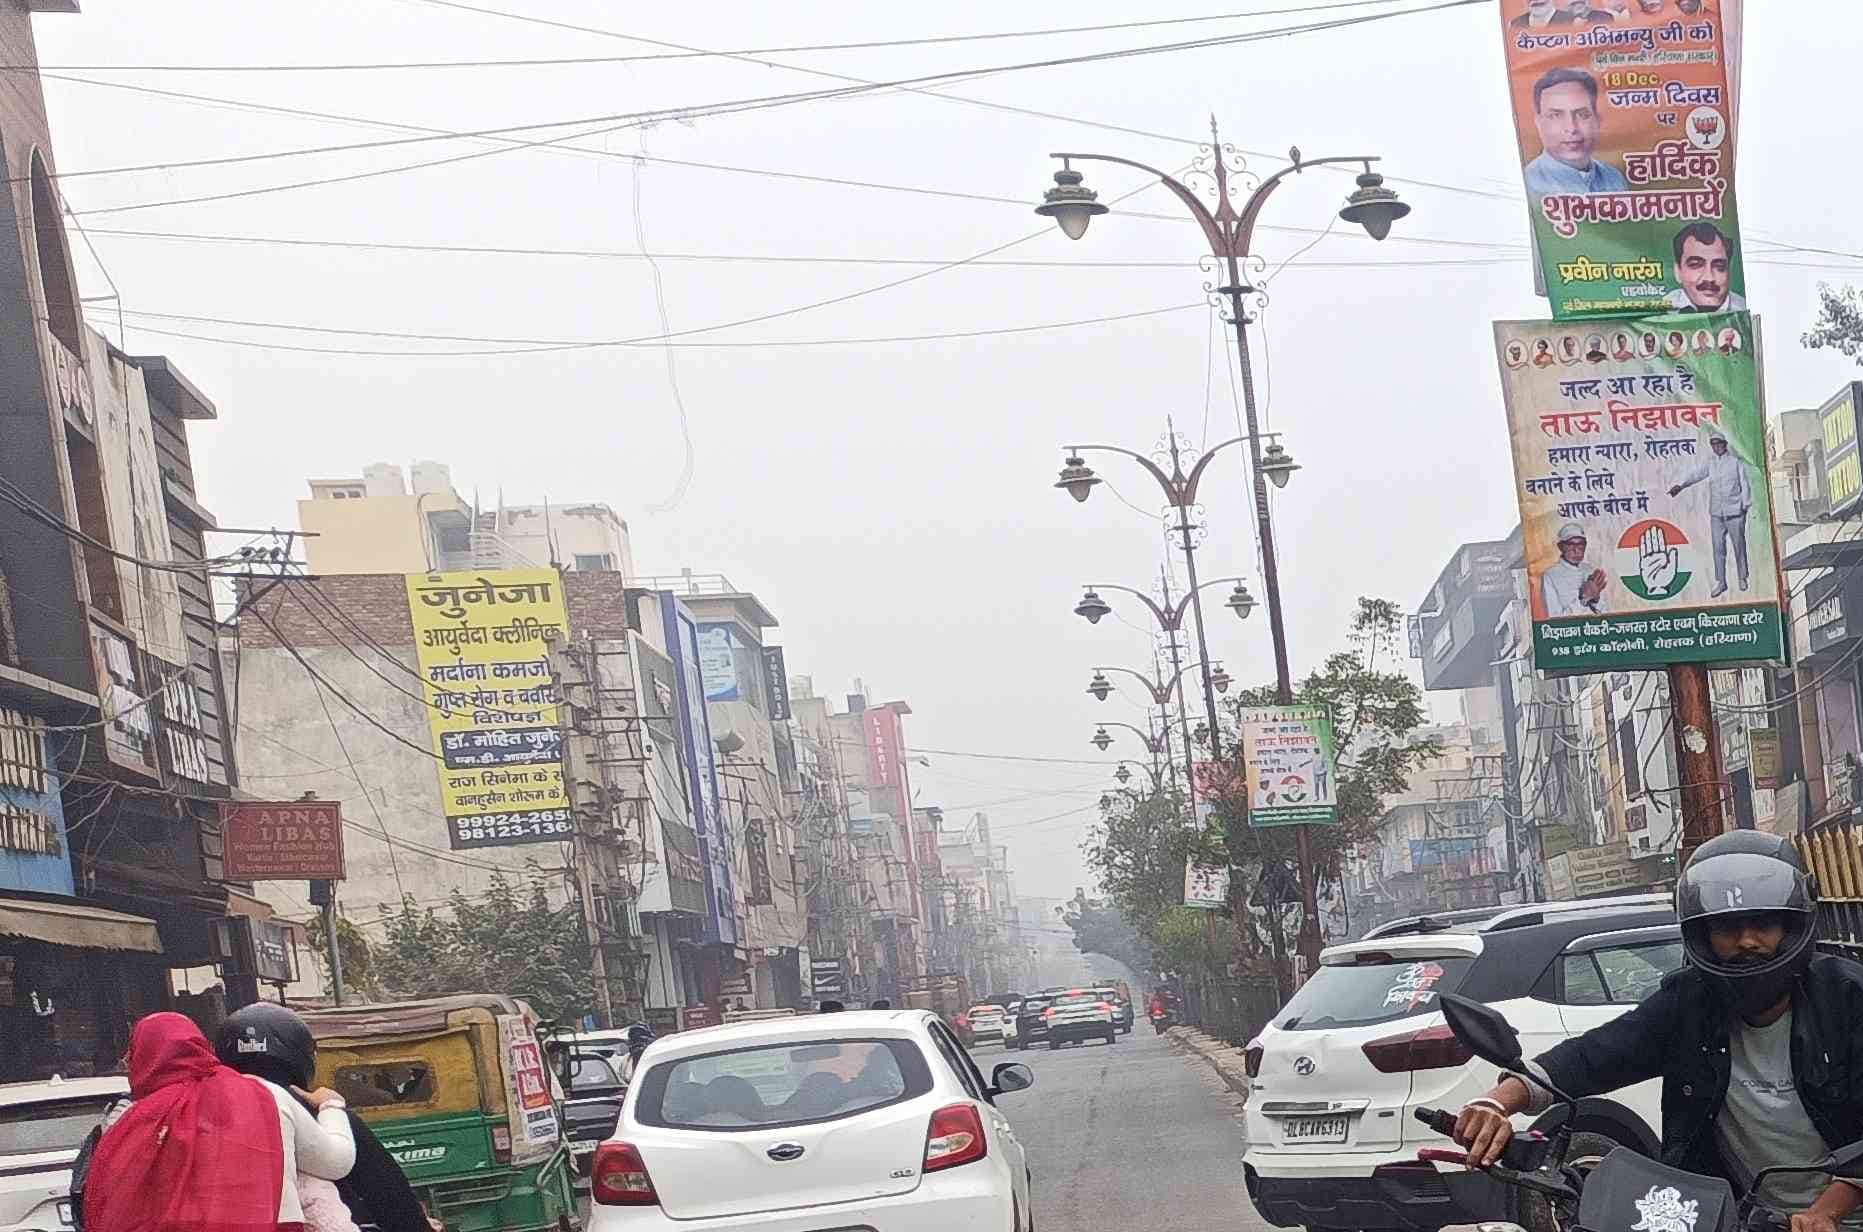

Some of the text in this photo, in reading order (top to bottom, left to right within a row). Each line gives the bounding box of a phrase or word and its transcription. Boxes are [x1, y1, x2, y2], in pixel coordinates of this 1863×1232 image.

[1577, 26, 1654, 49] अभिमन्यु
[1660, 24, 1682, 42] जी
[1690, 22, 1713, 41] को
[1602, 72, 1663, 86] 18 Dec.
[1607, 81, 1720, 106] जन्म दिवस
[1657, 112, 1676, 125] पर
[1624, 141, 1719, 183] हार्दिक
[1543, 181, 1726, 235] शुभकामनायें
[1557, 255, 1664, 285] प्रवीन नारंग
[1560, 365, 1695, 400] जल्द आ रहा है
[1539, 399, 1722, 437] ताऊ निझावन
[1548, 444, 1591, 467] हमारा
[1644, 435, 1696, 460] रोहतक
[1526, 470, 1564, 496] बनाने
[1568, 469, 1582, 491] के
[1557, 490, 1651, 519] आपके बीच में
[415, 577, 552, 619] जुनेजा
[1650, 616, 1672, 632] स्टोर
[1742, 609, 1764, 625] स्टोर
[423, 617, 562, 656] आयुर्वेदा क्लीनिक
[1699, 630, 1759, 647] (हरियाणा)
[428, 654, 551, 683] मर्दाना कमजो
[432, 691, 467, 720] गुप्त
[471, 684, 498, 707] रोग
[502, 688, 515, 705] व
[445, 733, 470, 750] डॉ.
[472, 729, 522, 747] मोहित
[448, 776, 476, 789] राज
[480, 770, 529, 787] सिनेमा
[532, 768, 548, 783] के
[548, 785, 560, 799] के
[258, 810, 331, 825] APNA
[458, 821, 572, 841] 98123-136
[261, 826, 331, 841] LIBAS
